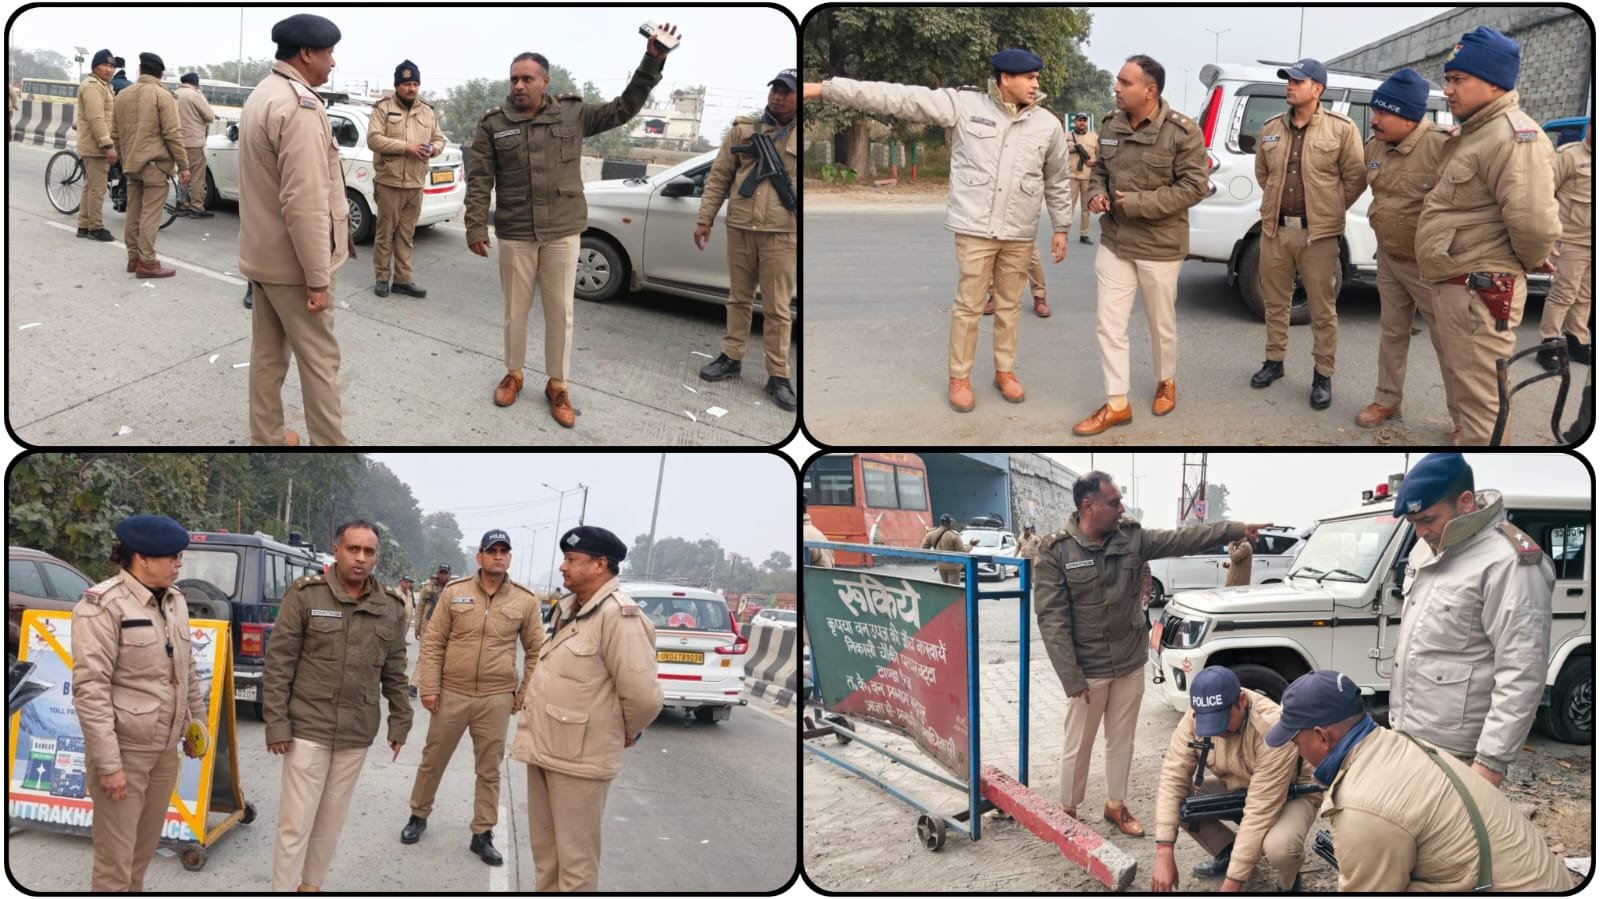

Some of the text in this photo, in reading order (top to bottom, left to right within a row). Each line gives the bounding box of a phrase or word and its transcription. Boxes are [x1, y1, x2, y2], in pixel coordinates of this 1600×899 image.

[1374, 98, 1401, 113] POLICE
[826, 617, 854, 637] कृपया
[1192, 694, 1223, 708] POLICE
[9, 799, 94, 828] UTTRAKHA
